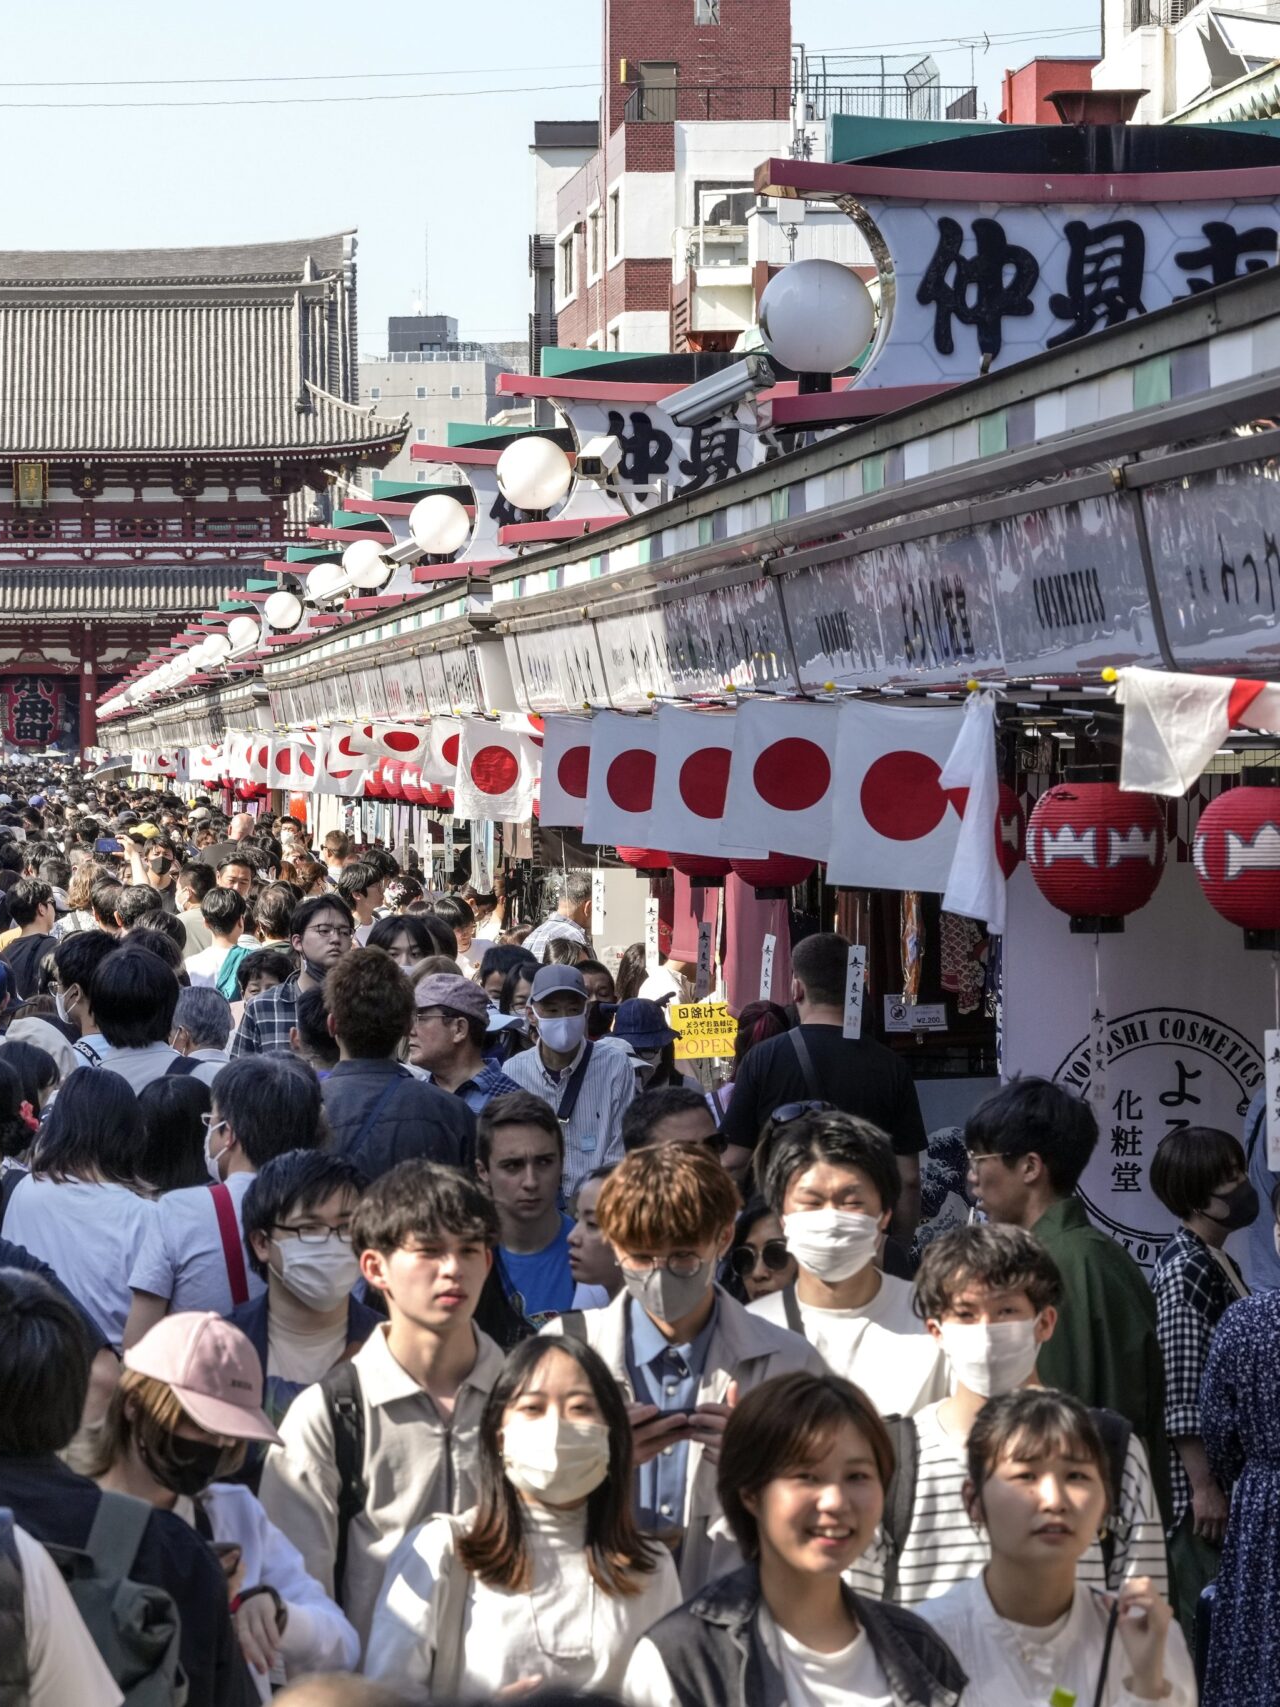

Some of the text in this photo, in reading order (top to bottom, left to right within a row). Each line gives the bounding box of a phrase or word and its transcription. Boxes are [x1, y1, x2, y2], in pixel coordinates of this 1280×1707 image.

[1033, 567, 1106, 630] COSMETICS
[11, 676, 55, 741] 小舟町
[1158, 1018, 1266, 1088] COSMETICS
[1110, 1089, 1144, 1192] 化粧堂
